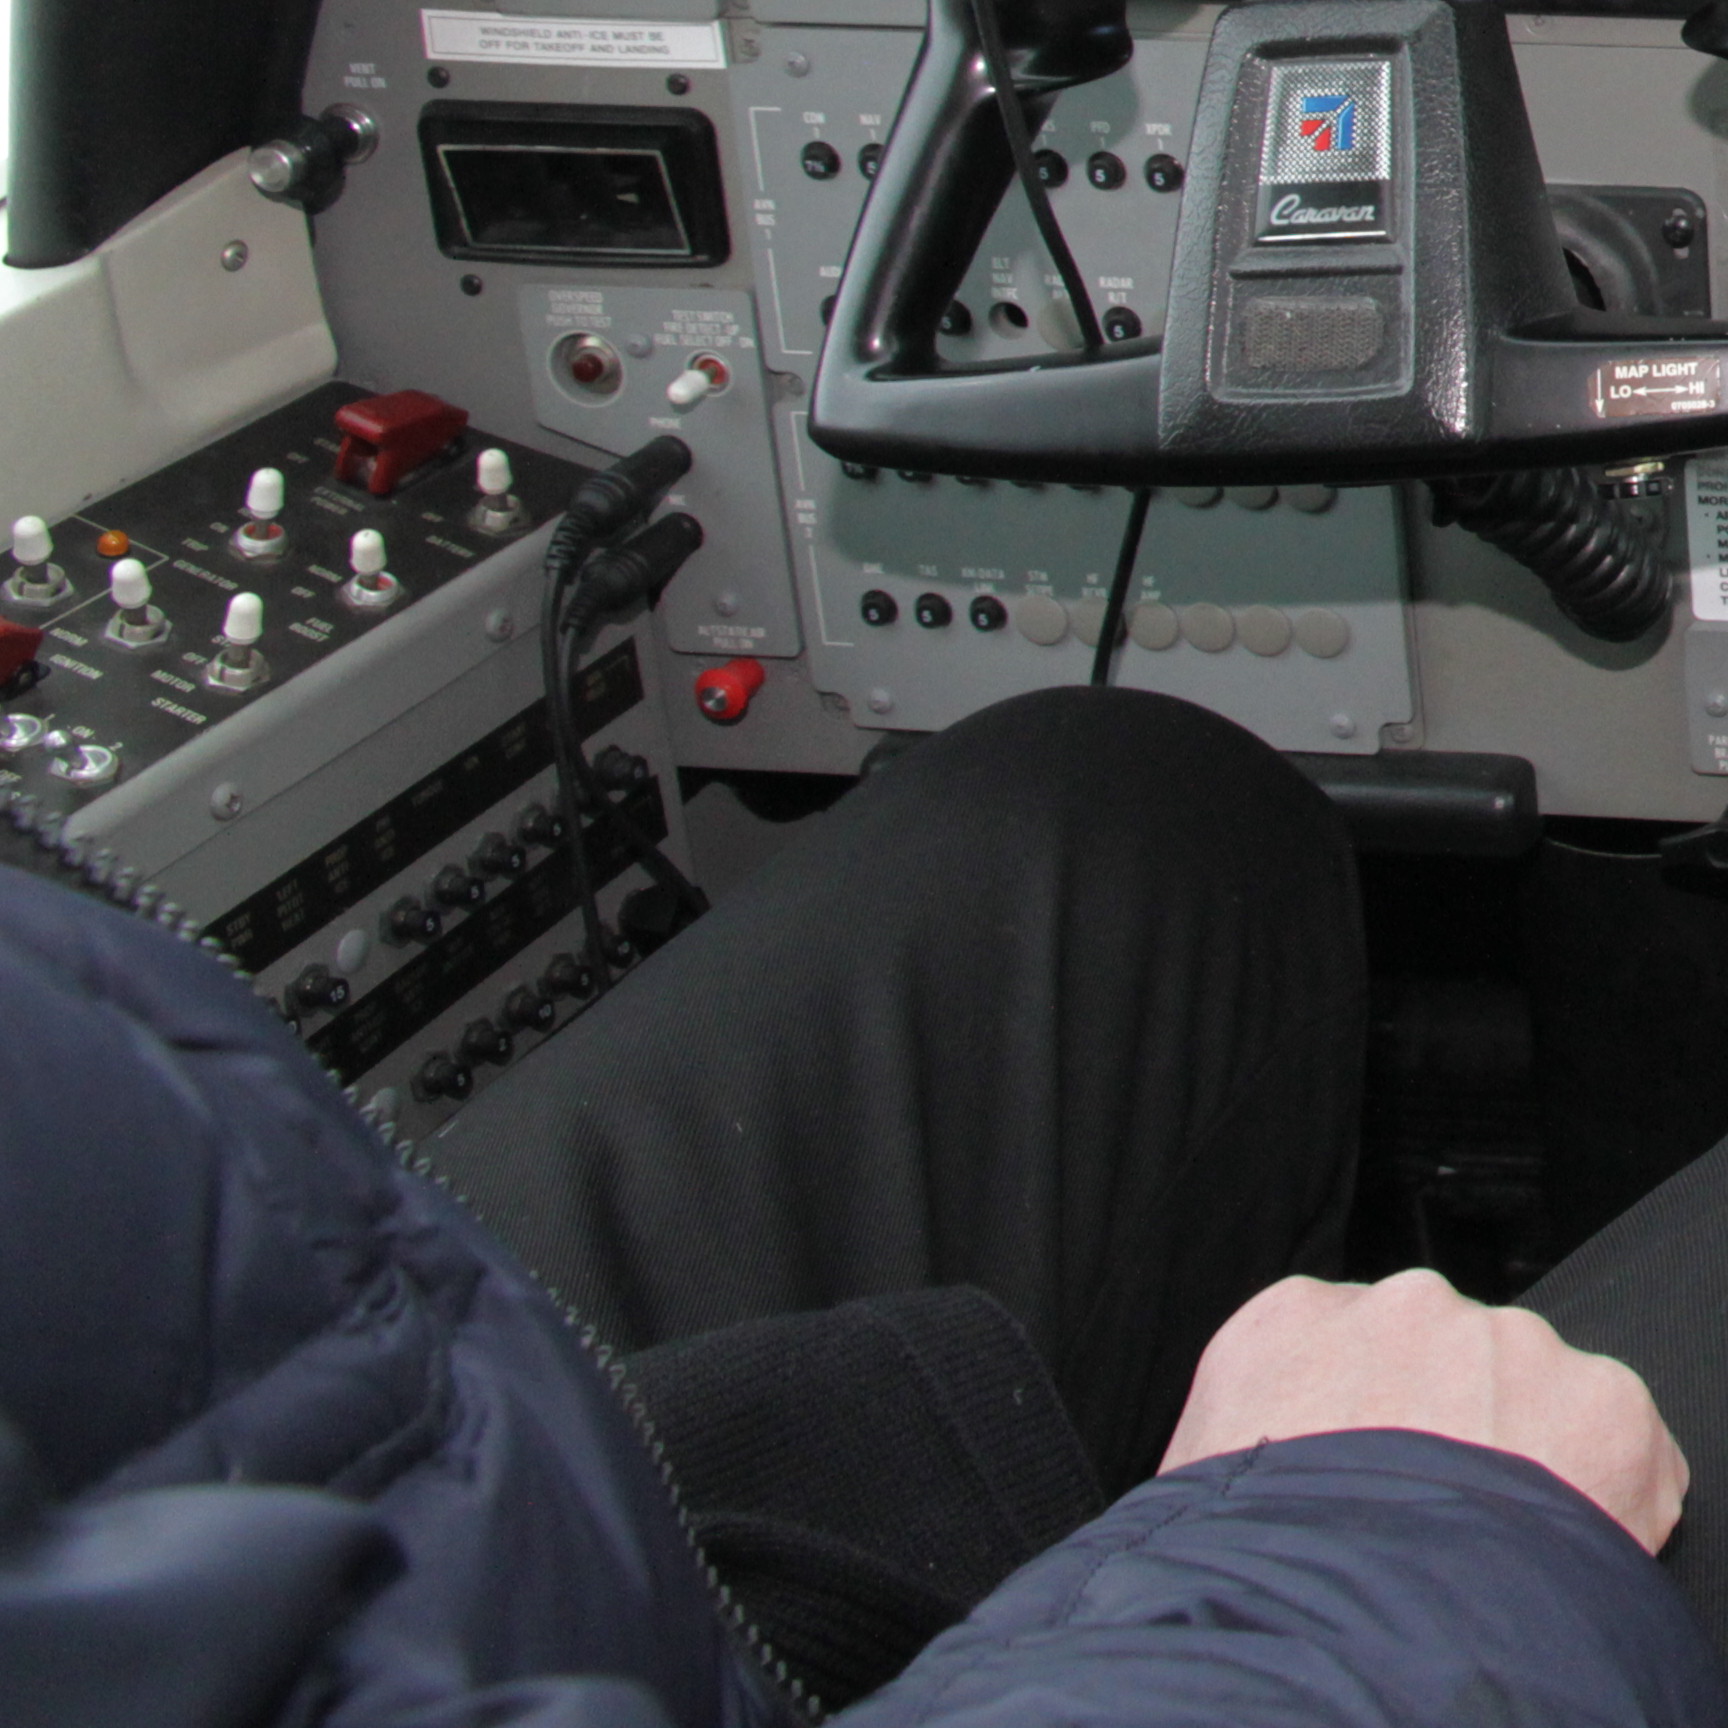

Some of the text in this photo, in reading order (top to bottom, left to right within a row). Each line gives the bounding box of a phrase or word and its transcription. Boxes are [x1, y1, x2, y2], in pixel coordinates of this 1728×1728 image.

[1270, 193, 1375, 226] Caravan
[1615, 363, 1698, 379] MAP LIGHT
[1610, 382, 1705, 399] LO HI
